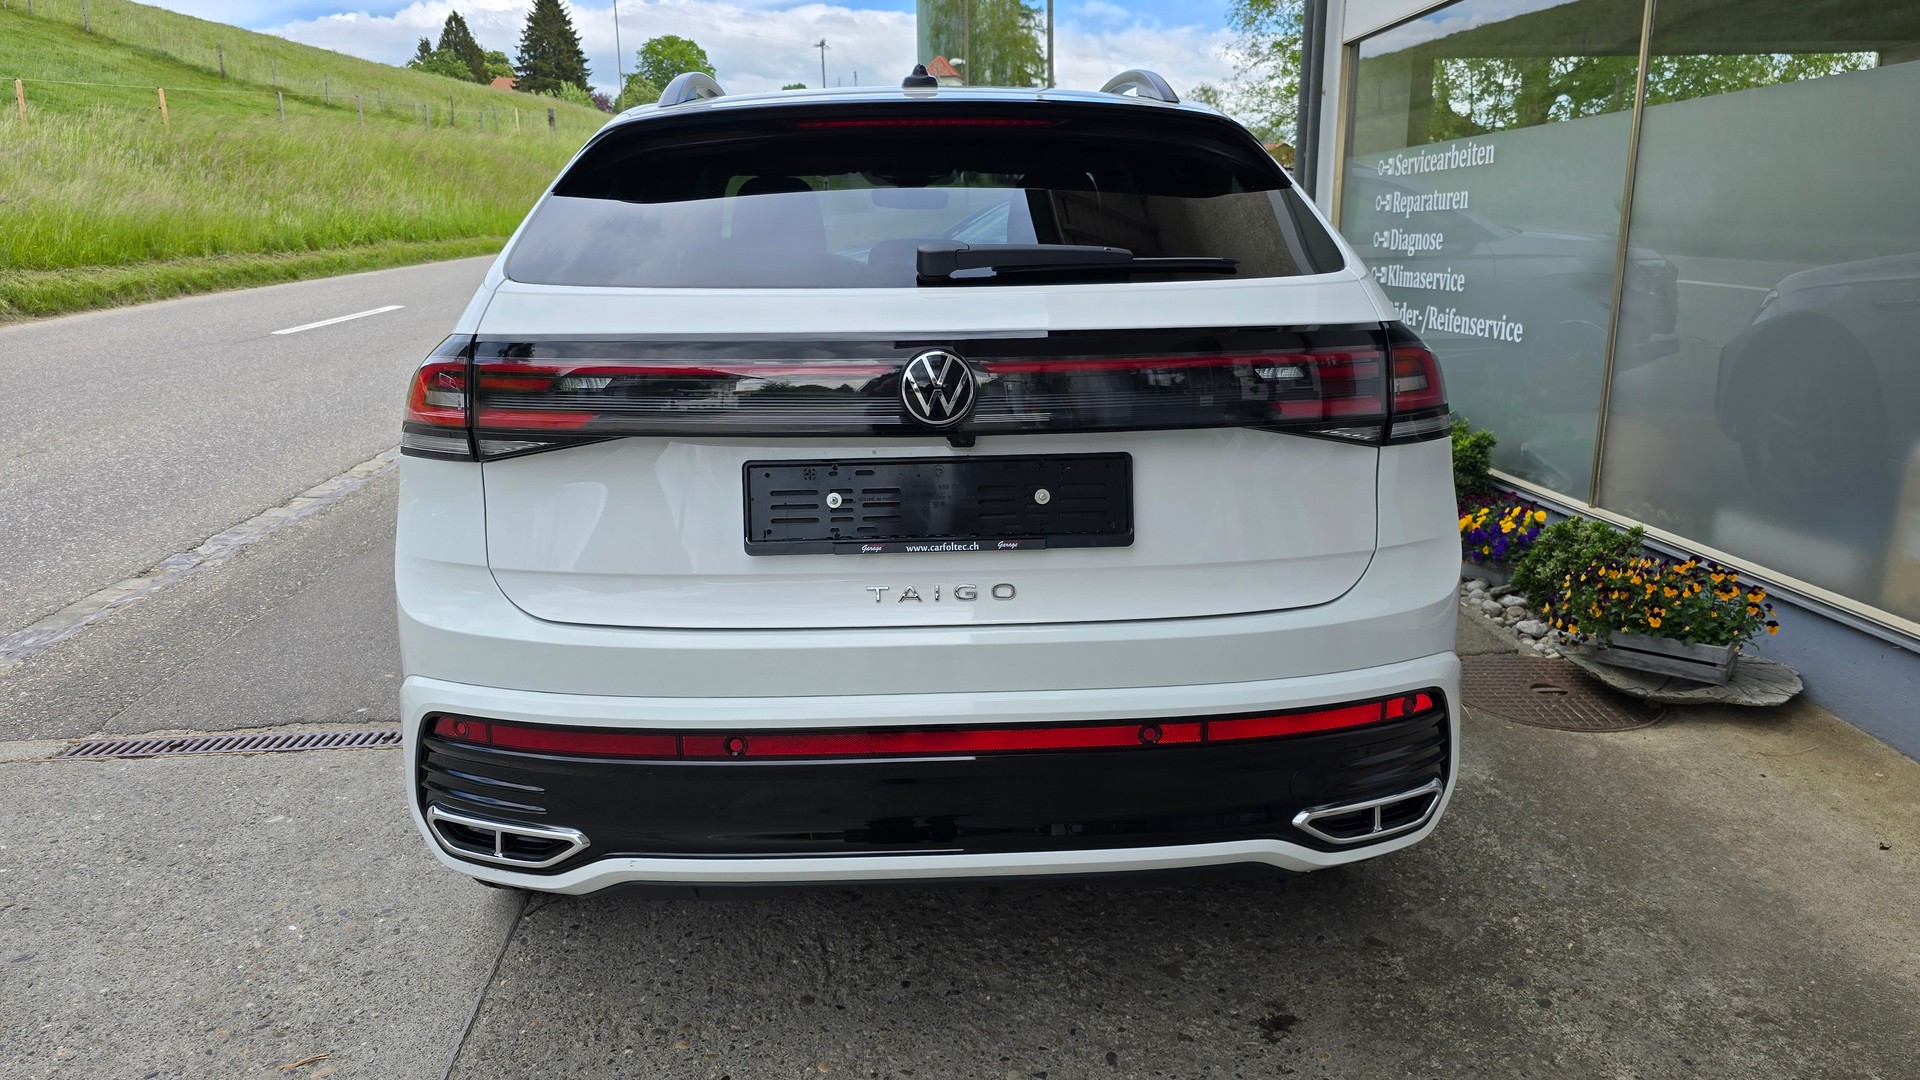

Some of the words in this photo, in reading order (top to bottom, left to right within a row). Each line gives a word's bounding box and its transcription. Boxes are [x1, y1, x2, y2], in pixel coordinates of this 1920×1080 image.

[1395, 141, 1495, 176] Servicearbeiten
[1392, 189, 1469, 219] Reparaturen
[1390, 228, 1444, 257] Diagnose
[1387, 264, 1465, 292] Klimaservice
[1390, 301, 1523, 343] der-/Reifenservice
[906, 541, 980, 552] www.carfoltec.ch
[866, 583, 1017, 603] TAIGO
